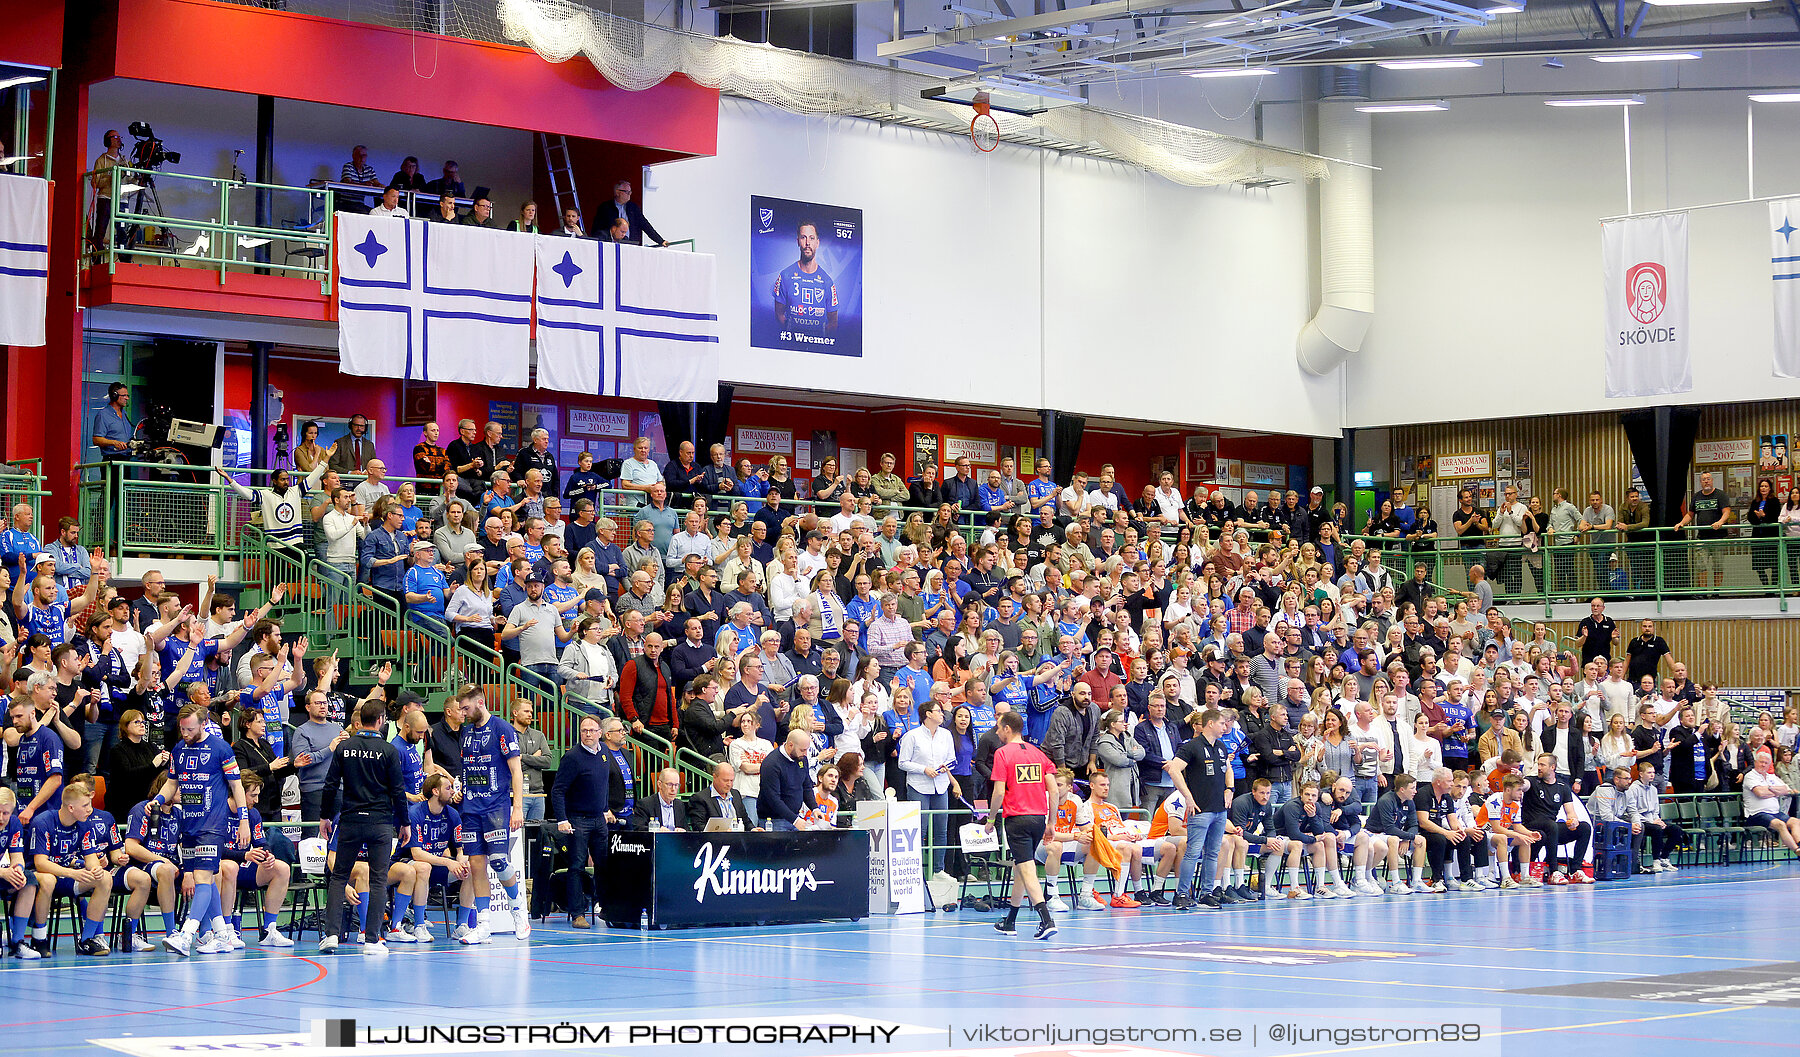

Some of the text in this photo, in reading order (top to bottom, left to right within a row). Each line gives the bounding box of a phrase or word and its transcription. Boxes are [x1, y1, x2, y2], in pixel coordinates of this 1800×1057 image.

[836, 229, 853, 239] 567
[780, 331, 836, 345] #3 Wremer
[1619, 327, 1676, 346] SKÖVDE
[573, 412, 626, 425] ARRANGEMANG
[588, 422, 611, 433] 2002
[741, 431, 789, 442] ARRANGEMANG
[753, 440, 776, 450] 2003
[948, 440, 993, 451] ARRANGEMANG
[1700, 442, 1750, 453] ARRANGEMANG
[961, 449, 982, 459] 2004
[1712, 451, 1735, 461] 2007
[1196, 459, 1207, 474] D
[1440, 456, 1487, 467] ARRANGEMANG
[1454, 465, 1475, 474] 2006
[463, 736, 472, 748] 14
[179, 752, 185, 765] 6
[343, 749, 383, 760] BRIXLY
[611, 834, 650, 855] Kinnarps
[891, 827, 919, 852] EY
[891, 856, 920, 869] Building
[898, 867, 920, 876] better
[892, 876, 921, 887] working
[893, 886, 913, 895] world
